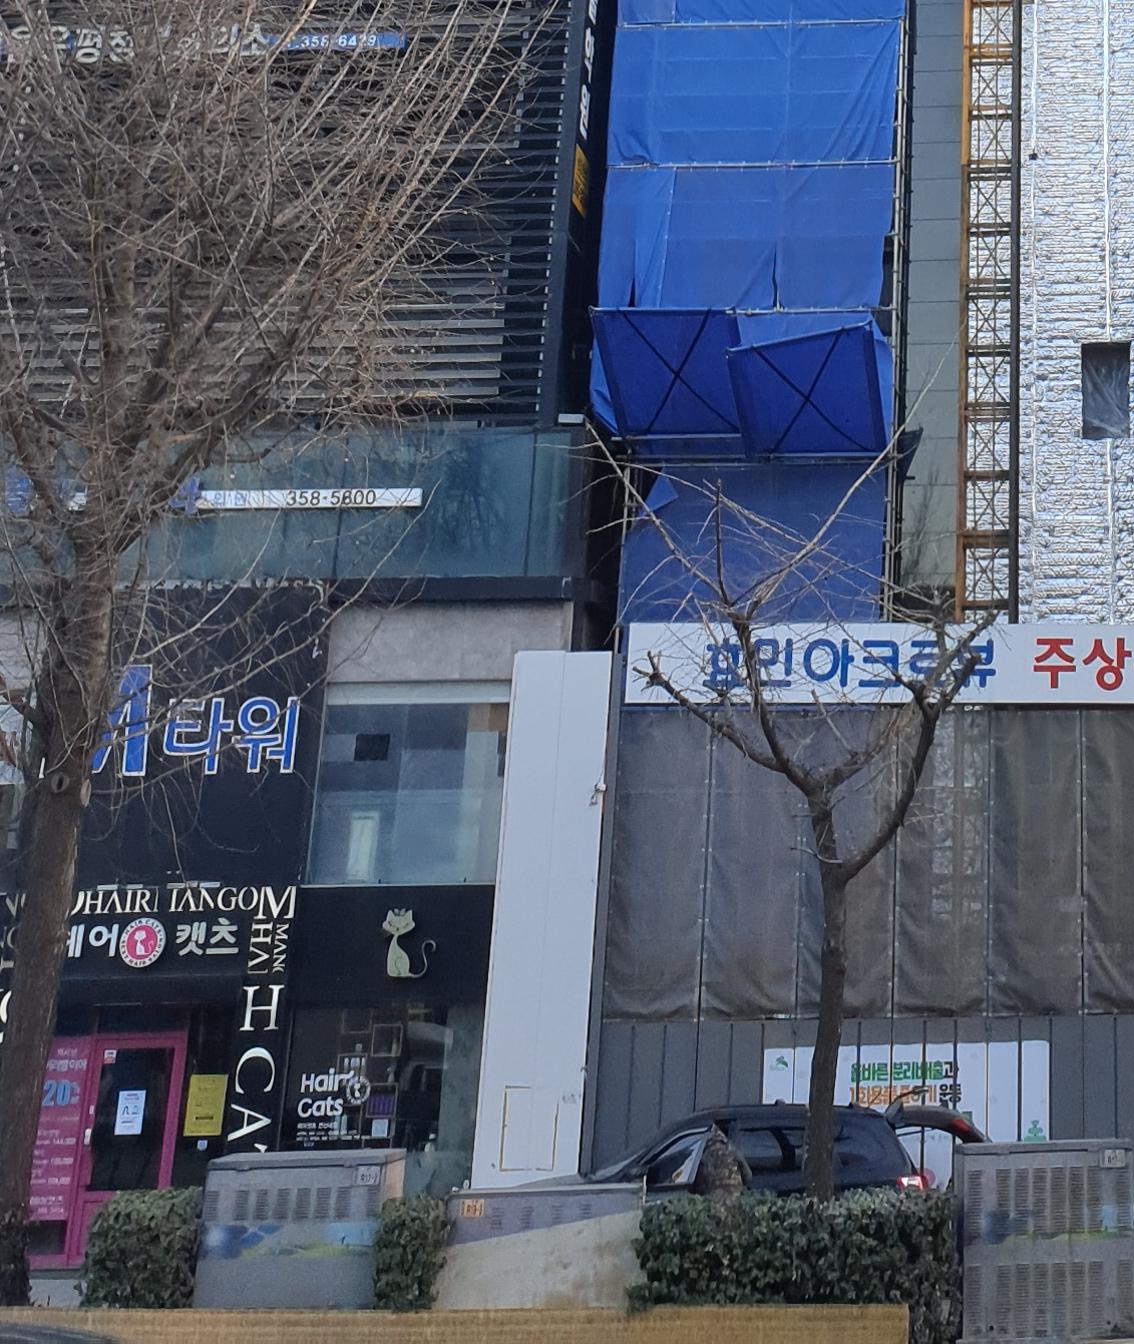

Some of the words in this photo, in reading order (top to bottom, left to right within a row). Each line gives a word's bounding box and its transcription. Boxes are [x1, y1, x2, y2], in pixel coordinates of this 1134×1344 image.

[176, 917, 240, 957] 캣츠
[300, 1068, 355, 1093] Hair
[297, 1096, 345, 1118] Cats
